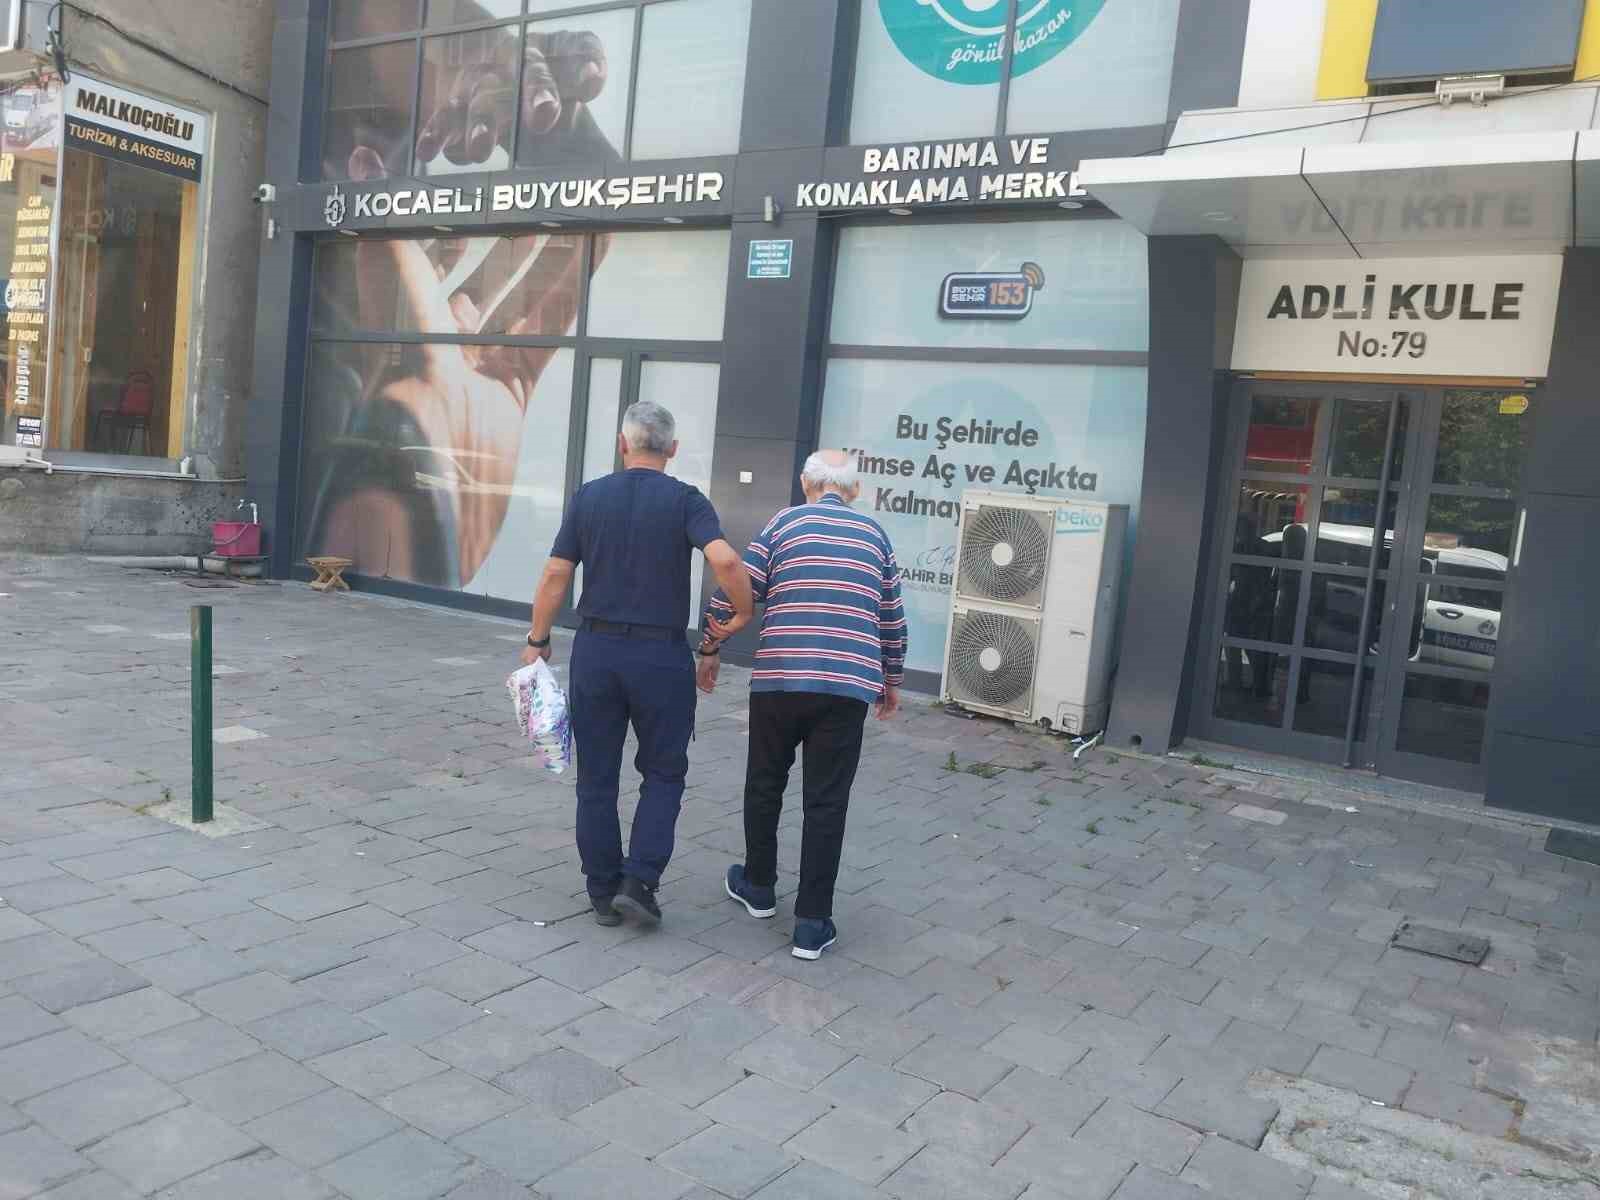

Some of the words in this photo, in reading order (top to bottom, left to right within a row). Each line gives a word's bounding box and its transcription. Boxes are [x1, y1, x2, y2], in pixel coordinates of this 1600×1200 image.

[946, 35, 1005, 70] gönül
[1013, 8, 1072, 55] kazan
[76, 88, 195, 142] MALKOÇOĞLU
[119, 138, 129, 151] &
[130, 142, 197, 170] AKSESUAR
[863, 140, 999, 174] BARINMA
[1010, 138, 1050, 165] VE
[796, 175, 969, 207] KONAKLAMA
[989, 283, 1025, 305] 153
[1266, 274, 1377, 320] ADLİ
[1388, 282, 1524, 320] KULE
[1336, 330, 1428, 359] No:79
[896, 414, 929, 441] Bu
[934, 416, 1039, 450] Şehirde
[842, 448, 915, 477] imse
[921, 454, 957, 489] Aç
[964, 464, 996, 484] ve
[1003, 459, 1097, 495] Açıkta
[1056, 508, 1104, 527] beko
